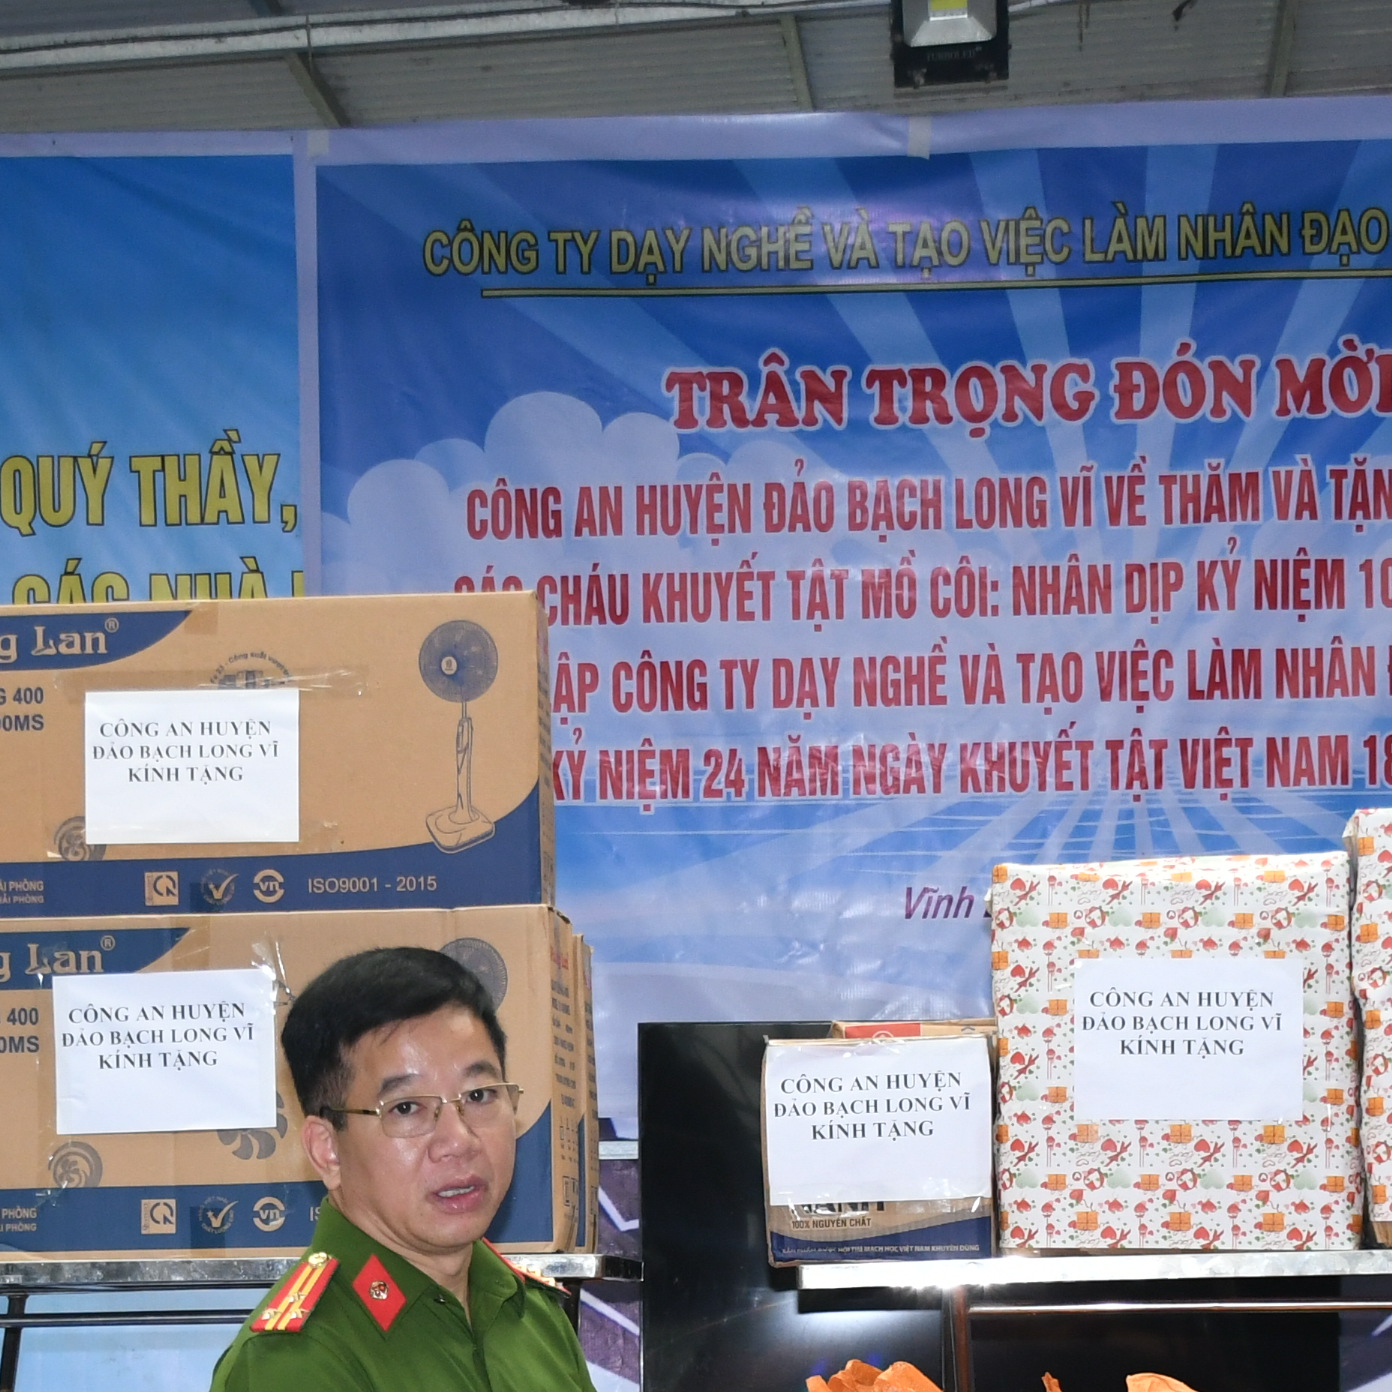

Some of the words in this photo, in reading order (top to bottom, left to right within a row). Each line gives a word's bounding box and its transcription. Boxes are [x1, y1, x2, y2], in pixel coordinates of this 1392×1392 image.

[424, 219, 539, 275] CÔNG
[548, 230, 600, 274] TY
[611, 227, 692, 285] DẠY
[701, 206, 813, 271] NGHỀ
[822, 208, 878, 268] VÀ
[888, 219, 970, 279] TẠO
[982, 207, 1071, 276] VIỆC
[1083, 202, 1167, 263] LÀM
[1179, 203, 1290, 259] NHÂN
[1302, 206, 1388, 266] ĐẠO
[665, 351, 847, 429] TRÂN
[866, 362, 1095, 438] TRỌNG
[1114, 341, 1255, 421] ĐÓN
[0, 441, 114, 537] QUÝ
[129, 428, 298, 532] THẦY,
[466, 478, 562, 540] CÔNG
[574, 485, 623, 537] AN
[636, 472, 752, 546] HUYỆN
[763, 458, 834, 533] ĐẢO
[847, 477, 942, 543] BẠCH
[955, 476, 1047, 530] LONG
[1060, 466, 1095, 528] VĨ
[1104, 456, 1147, 527] VỀ
[1158, 461, 1261, 524] THĂM
[1272, 455, 1319, 521] VÀ
[537, 562, 629, 627] CHÁU
[642, 551, 776, 624] KHUYẾT
[786, 556, 849, 632] TẬT
[861, 550, 917, 620] MỒ
[930, 555, 999, 617] CÔI:
[1012, 553, 1111, 616] NHÂN
[1125, 562, 1184, 624] DỊP
[1197, 536, 1242, 612] KỶ
[1254, 547, 1345, 622] NIỆM
[31, 625, 108, 656] Lan
[612, 649, 708, 713] CÔNG
[719, 658, 759, 710] TY
[772, 657, 840, 720] DẠY
[853, 635, 947, 707] NGHỀ
[960, 642, 1006, 705] VÀ
[1016, 652, 1082, 715] TẠO
[1096, 639, 1174, 713] VIỆC
[1187, 638, 1262, 701] LÀM
[1275, 636, 1375, 700] NHÂN
[13, 687, 44, 704] 400
[100, 718, 159, 738] CÔNG
[165, 721, 193, 737] AN
[200, 719, 272, 740] HUYỆN
[93, 740, 133, 761] ĐẢO
[140, 743, 192, 764] BẠCH
[199, 742, 254, 759] LONG
[259, 740, 279, 758] VĨ
[128, 761, 180, 783] KÍNH
[186, 765, 243, 785] TẶNG
[599, 738, 690, 812] NIỆM
[702, 748, 745, 798] 24
[758, 734, 839, 797] NĂM
[852, 732, 946, 796] NGÀY
[959, 722, 1094, 793] KHUYẾT
[1106, 726, 1168, 802] TẬT
[1179, 726, 1253, 800] VIỆT
[1266, 735, 1349, 788] NAM
[308, 878, 379, 894] ISO9001
[396, 876, 437, 892] 2015
[904, 886, 975, 920] Vĩnh
[25, 943, 104, 975] Lan
[1089, 987, 1153, 1008] CÔNG
[1160, 991, 1190, 1007] AN
[1198, 989, 1274, 1011] HUYỆN
[7, 1008, 39, 1026] 400
[68, 1003, 130, 1025] CÔNG
[136, 1005, 165, 1022] AN
[171, 1002, 246, 1022] HUYỆN
[1082, 1012, 1125, 1031] ĐẢO
[1132, 1015, 1189, 1034] BẠCH
[1196, 1015, 1255, 1031] LONG
[1261, 1013, 1282, 1031] VĨ
[61, 1027, 103, 1047] ĐẢO
[110, 1028, 164, 1049] BẠCH
[170, 1026, 228, 1044] LONG
[234, 1023, 254, 1041] VĨ
[1120, 1035, 1175, 1055] KÍNH
[1183, 1038, 1244, 1059] TẶNG
[98, 1049, 153, 1070] KÍNH
[158, 1050, 218, 1071] TẶNG
[780, 1073, 843, 1095] CÔNG
[850, 1075, 879, 1092] AN
[886, 1070, 962, 1092] HUYỆN
[774, 1098, 817, 1118] ĐẢO
[823, 1098, 879, 1119] BẠCH
[886, 1096, 943, 1113] LONG
[946, 1092, 971, 1111] VĨ
[811, 1119, 866, 1140] KÍNH
[872, 1119, 934, 1142] TẶNG
